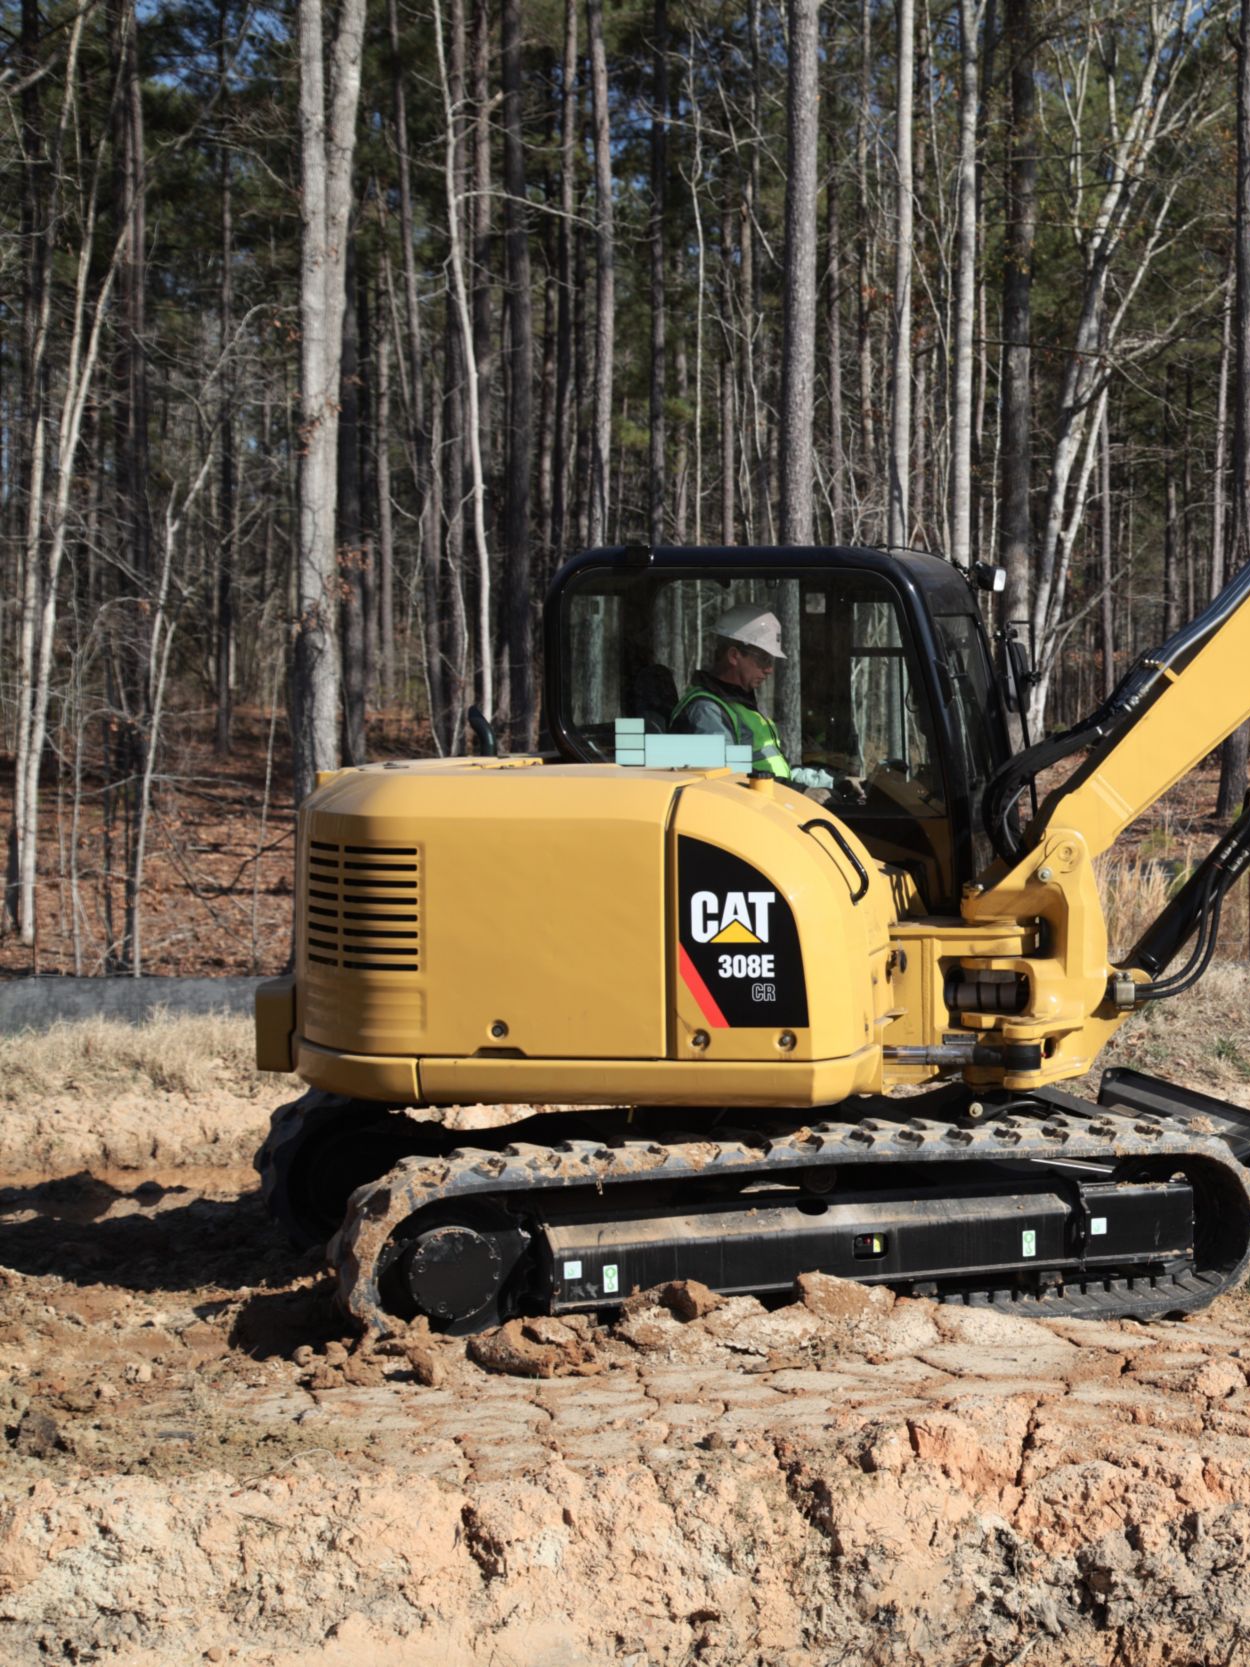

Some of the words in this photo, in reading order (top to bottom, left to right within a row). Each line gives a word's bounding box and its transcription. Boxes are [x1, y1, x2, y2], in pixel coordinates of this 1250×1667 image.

[690, 890, 776, 944] CAT
[718, 954, 775, 978] 308E
[752, 983, 776, 1002] CR
